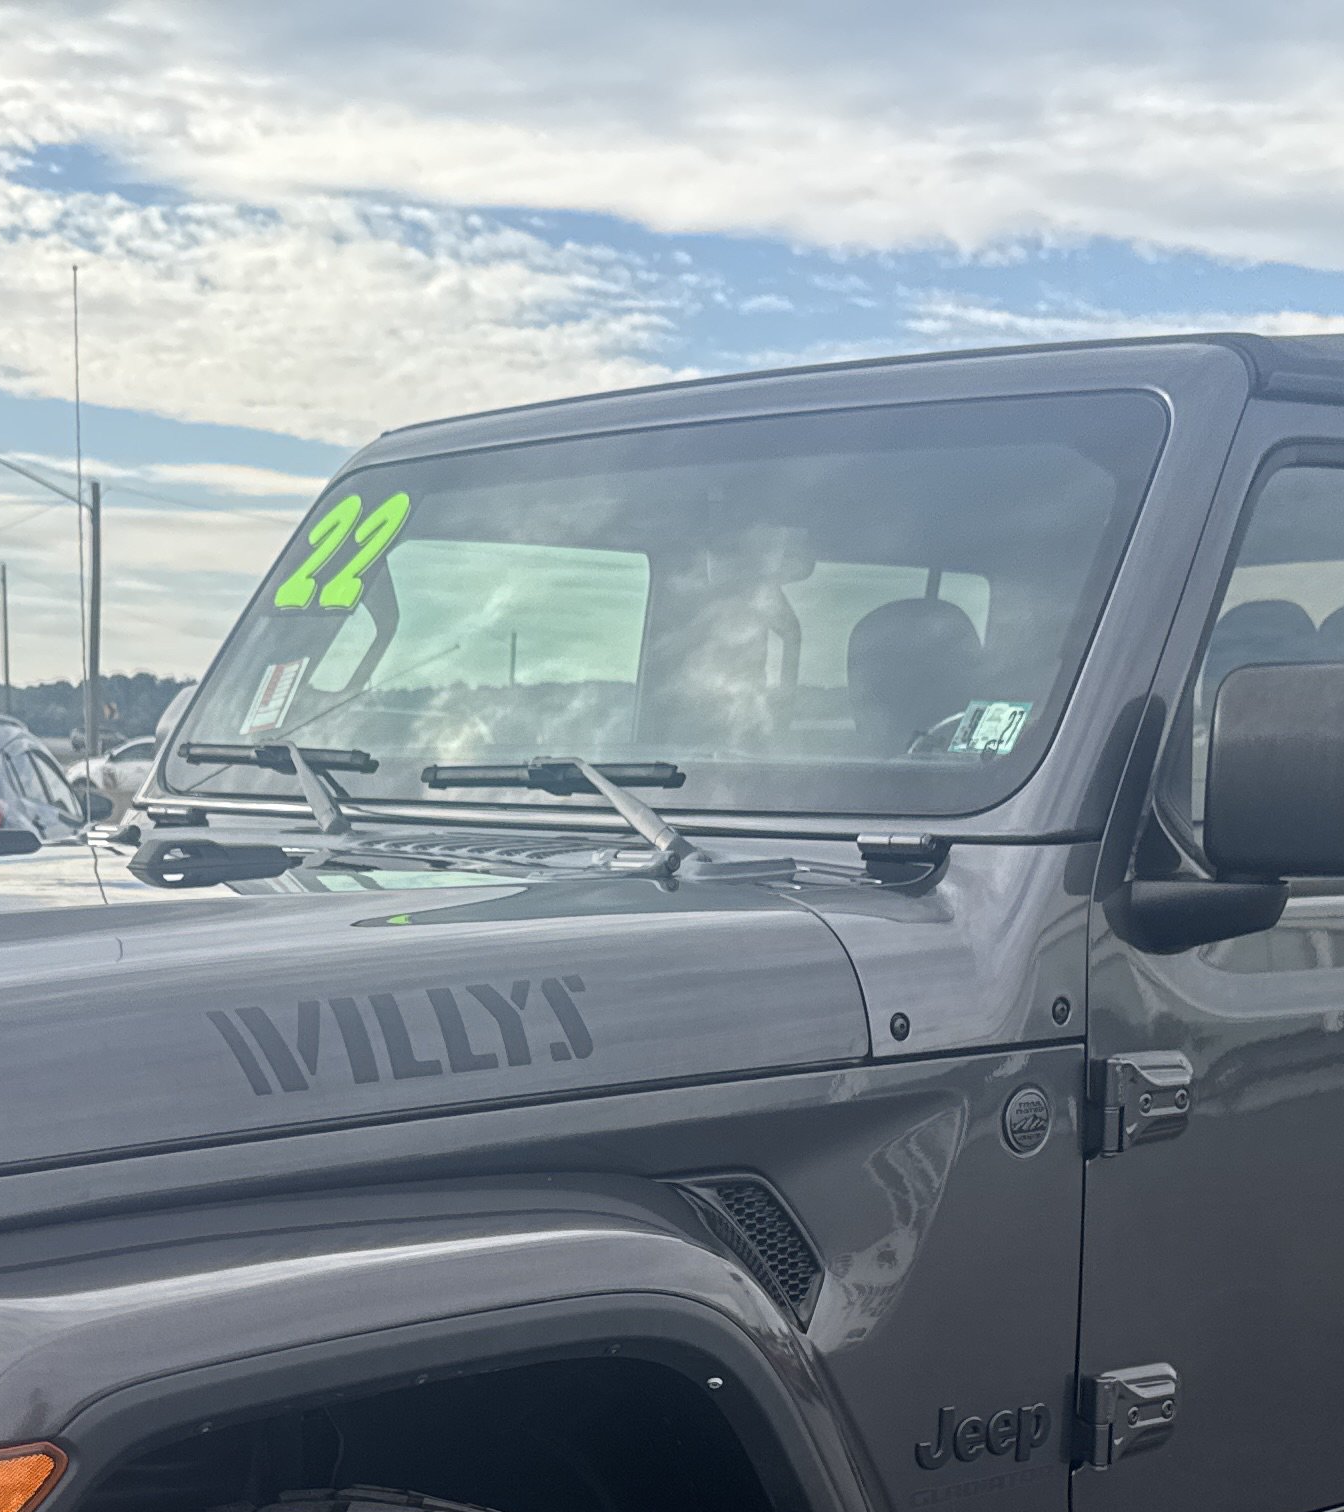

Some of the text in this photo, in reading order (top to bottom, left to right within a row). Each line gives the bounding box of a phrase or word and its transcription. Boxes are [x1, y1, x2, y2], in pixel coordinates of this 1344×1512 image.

[274, 492, 412, 610] 22
[206, 974, 595, 1097] WILLYS
[914, 1402, 1052, 1471] Jeep
